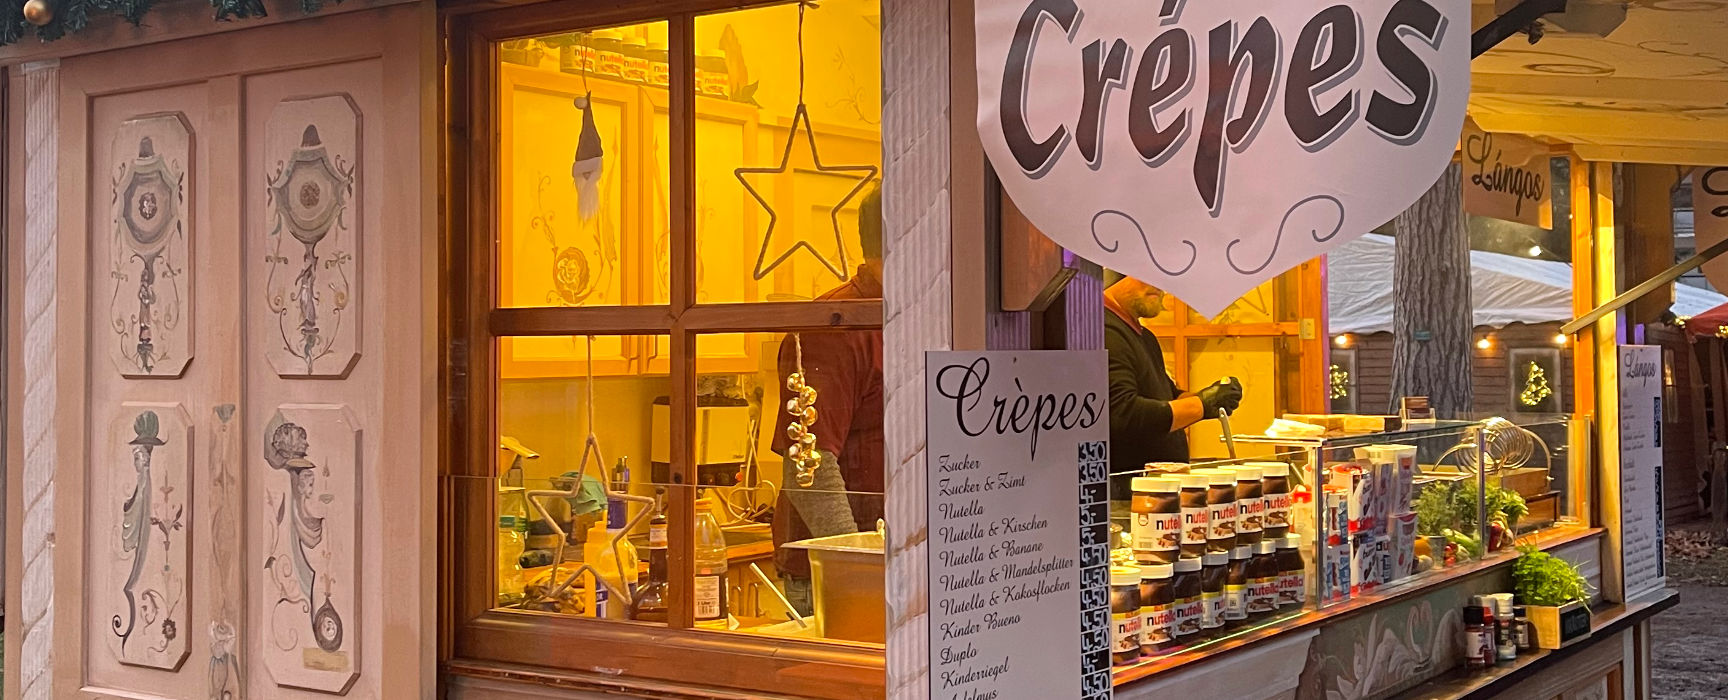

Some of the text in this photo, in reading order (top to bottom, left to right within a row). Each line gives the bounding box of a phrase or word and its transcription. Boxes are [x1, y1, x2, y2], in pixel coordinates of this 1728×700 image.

[1467, 132, 1544, 217] Lángos
[936, 357, 1105, 461] Crèpes
[939, 454, 981, 472] Zucker
[939, 471, 1025, 496] Zucker & Zimt
[939, 499, 984, 520] Nutella
[1156, 515, 1181, 530] nutel
[939, 515, 1048, 543] Nutella & Kirschen
[939, 540, 1043, 567] Nutella & Banane
[939, 555, 1073, 591] Nutella & Mandelsplitter
[940, 577, 1070, 616] Nutella & Kokosflocken
[940, 612, 1021, 640] Kinder Bueno
[940, 642, 977, 667] Duplo
[940, 656, 1010, 689] Kinderriegel
